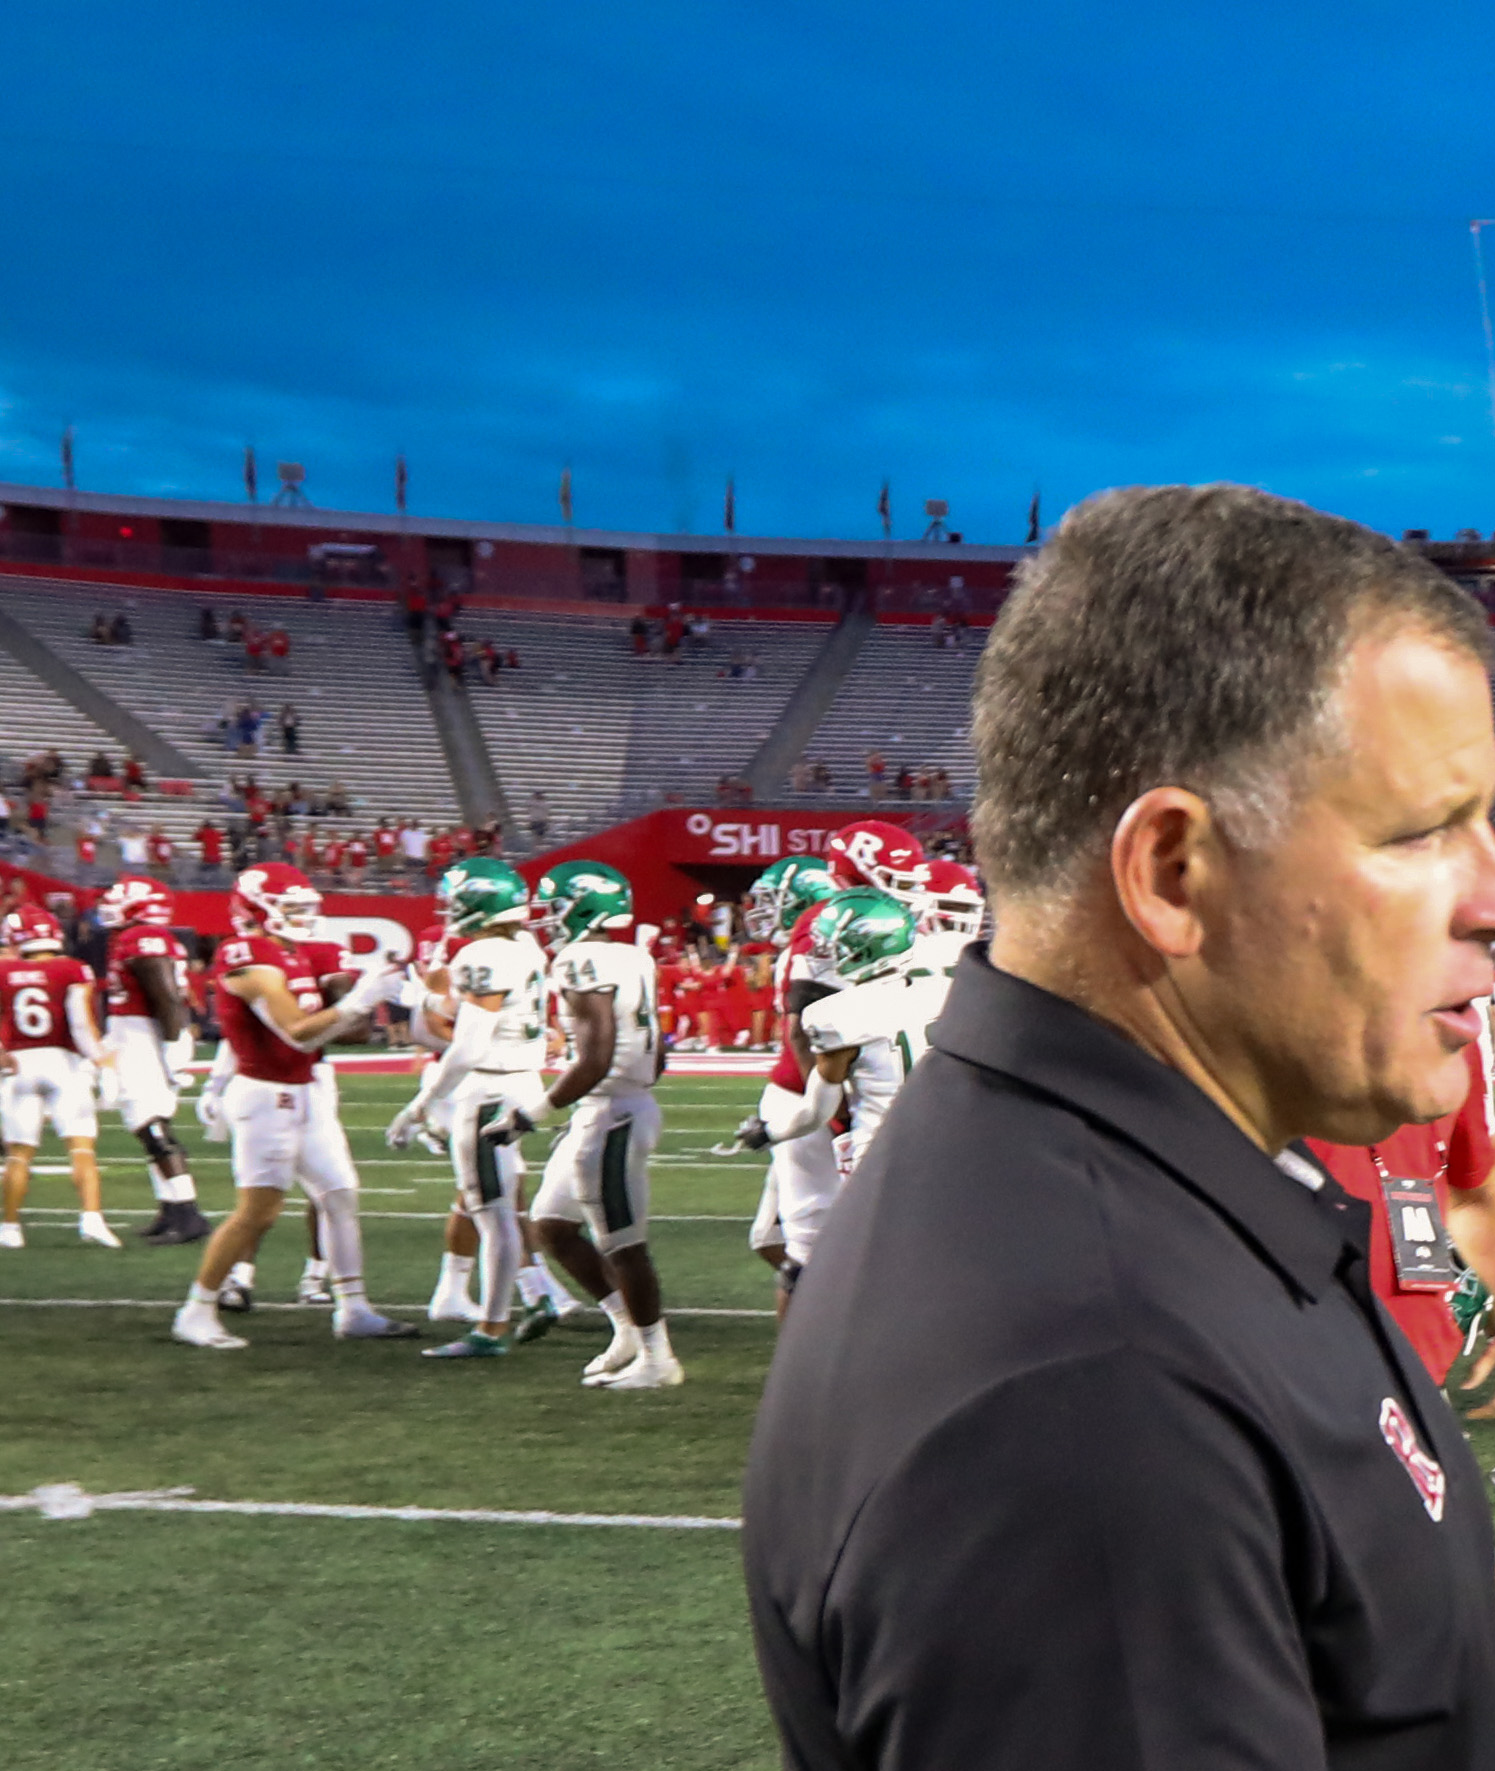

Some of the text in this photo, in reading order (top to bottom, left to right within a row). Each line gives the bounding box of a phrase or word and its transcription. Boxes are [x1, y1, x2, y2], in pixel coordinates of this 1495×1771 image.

[708, 823, 780, 856] SHI
[844, 831, 883, 866] R
[13, 986, 53, 1038] 6
